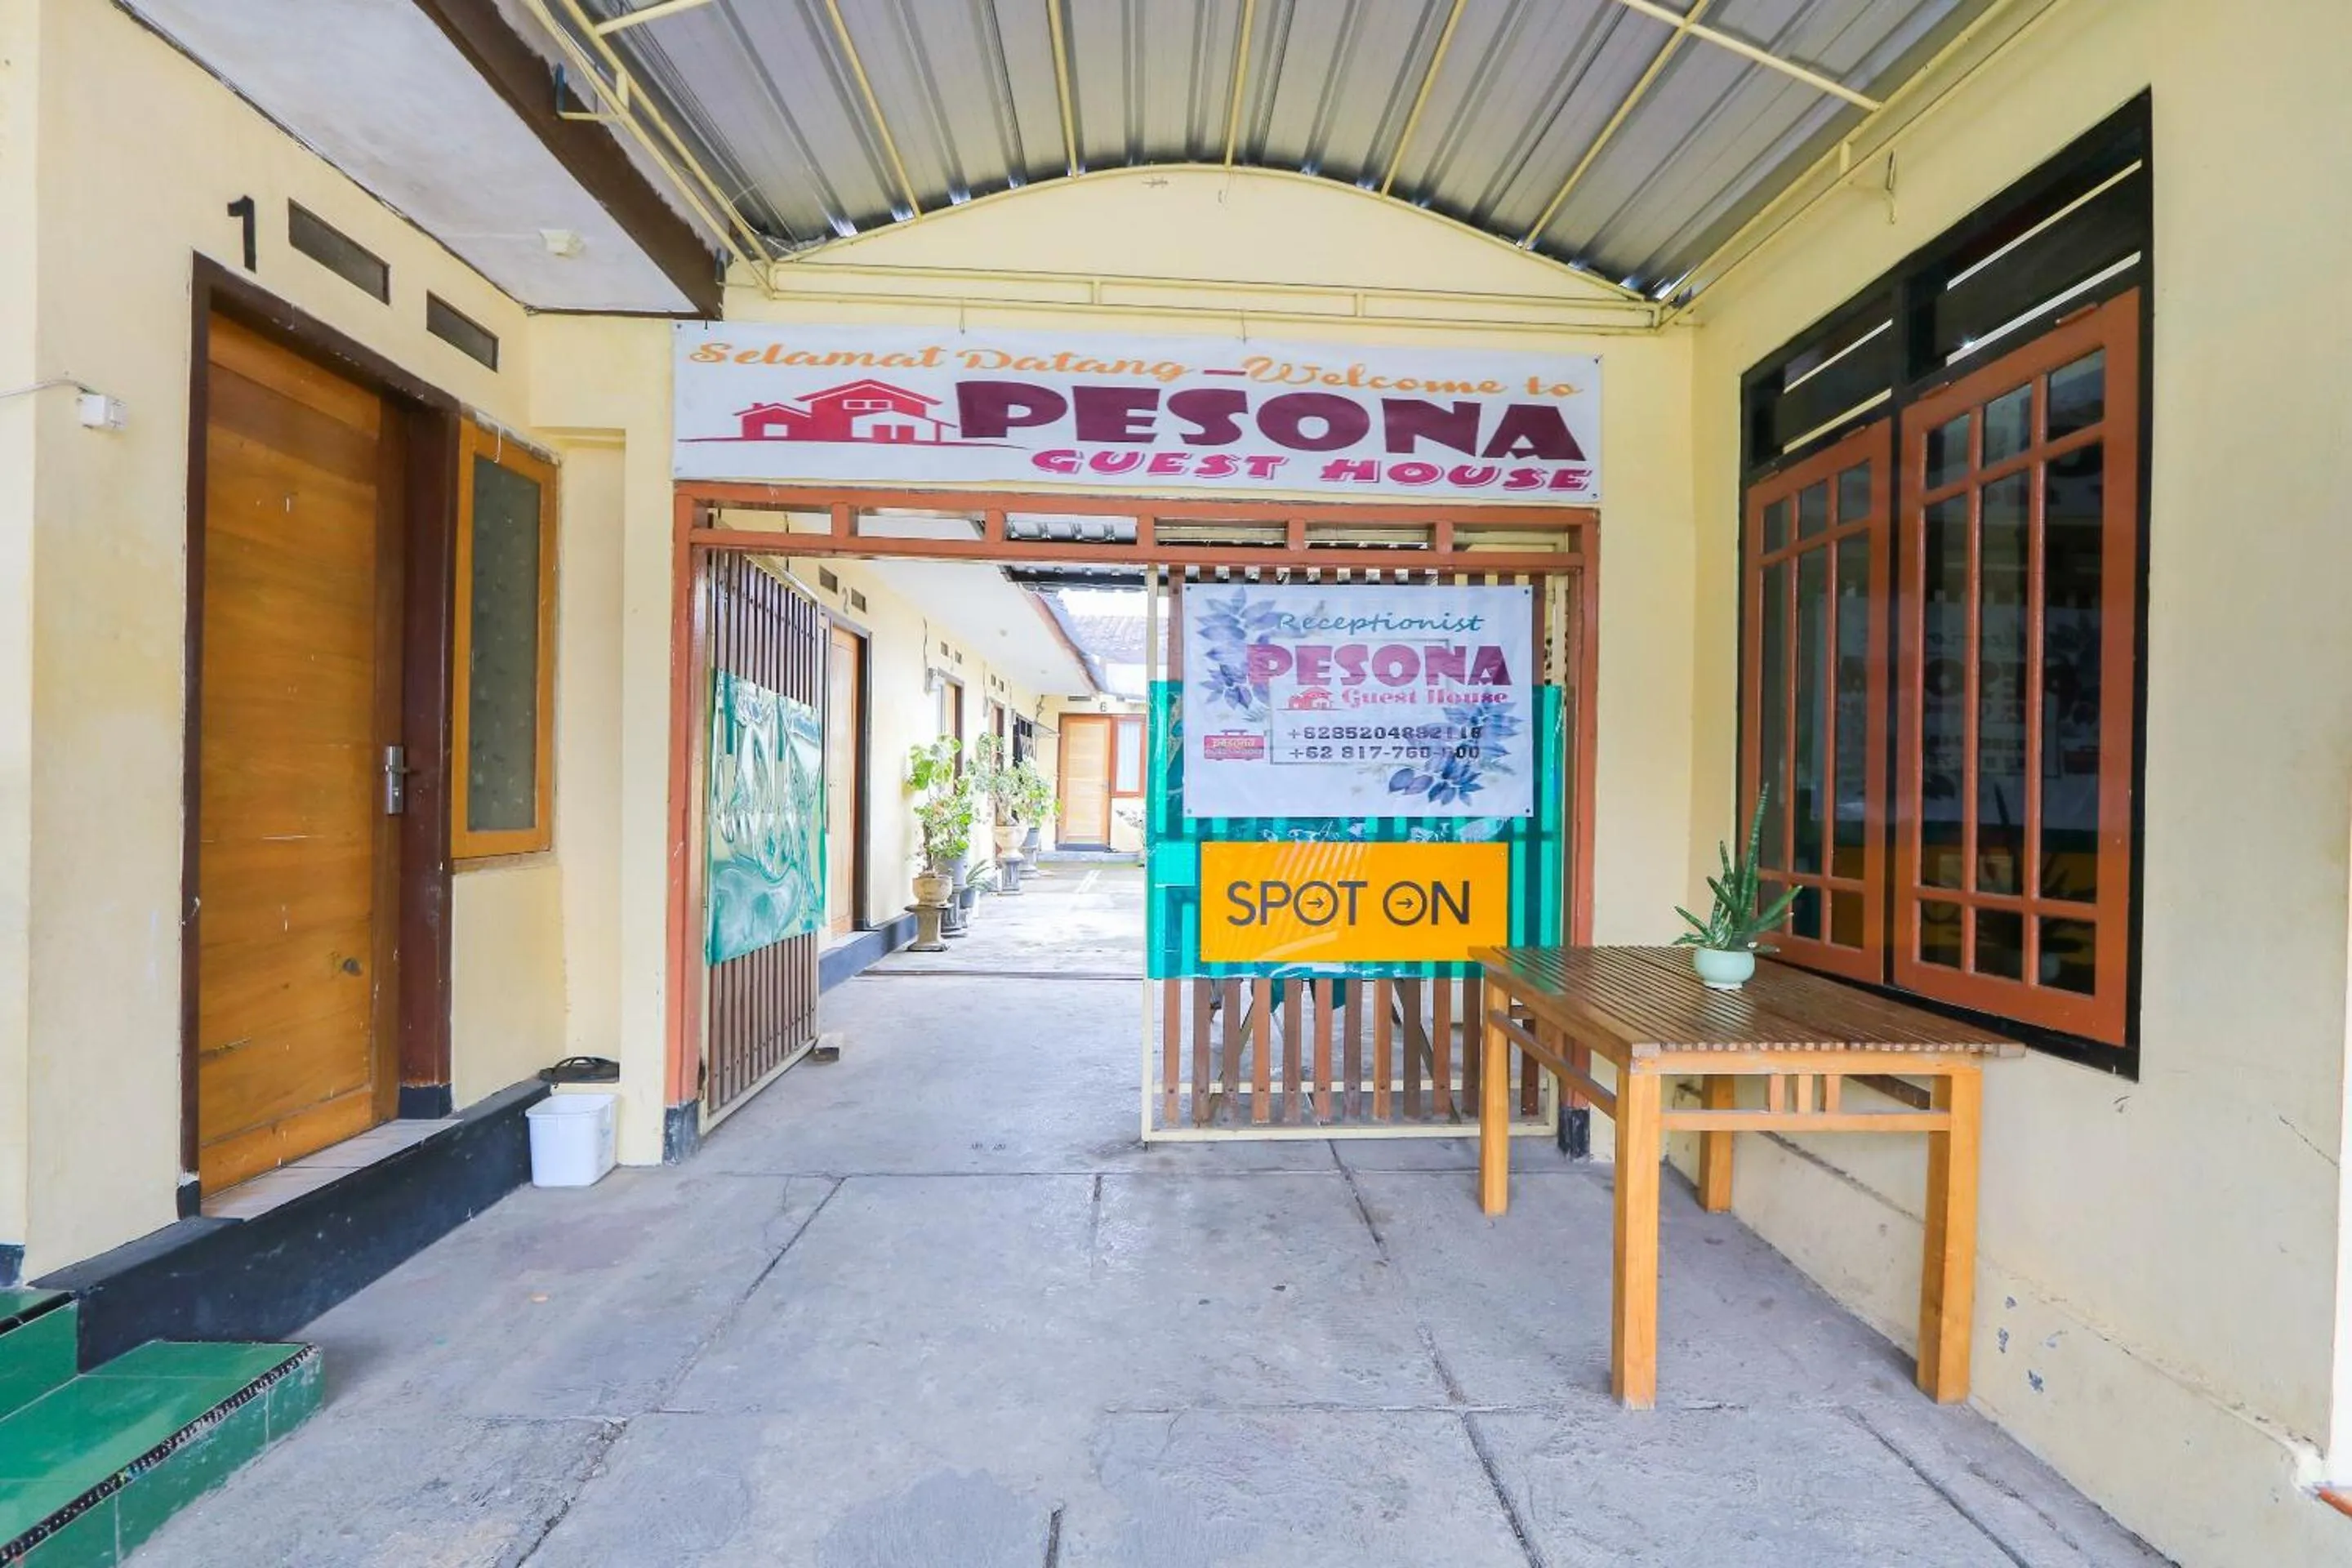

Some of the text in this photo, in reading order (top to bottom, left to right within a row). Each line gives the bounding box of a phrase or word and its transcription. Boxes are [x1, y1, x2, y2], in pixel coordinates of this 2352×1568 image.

[227, 194, 257, 274] 1
[690, 342, 948, 369] Selamat
[955, 348, 1197, 382] Datang
[1242, 356, 1508, 394] Welcome
[1523, 376, 1584, 398] to
[955, 381, 1586, 461] PESONA
[1031, 449, 1593, 492] GUEST HOUSE
[841, 586, 849, 615] 2
[1276, 612, 1486, 635] Receptionist
[1246, 643, 1512, 687] PESONA
[1342, 687, 1508, 708] Guest House
[1289, 746, 1333, 760] +62
[1227, 880, 1470, 926] SPOT ON
